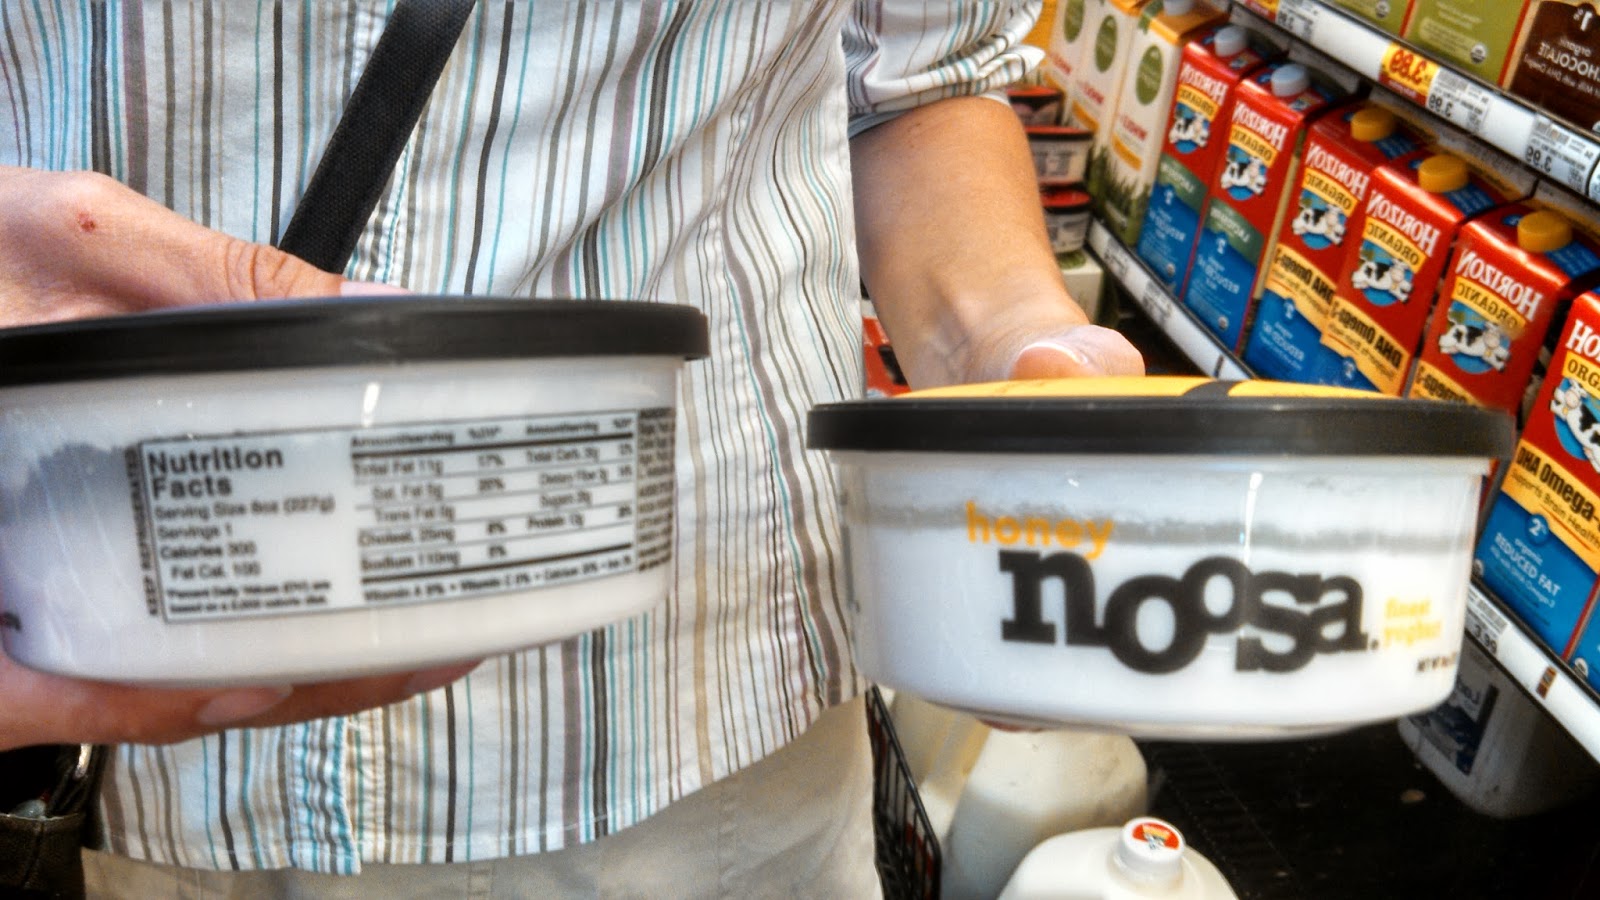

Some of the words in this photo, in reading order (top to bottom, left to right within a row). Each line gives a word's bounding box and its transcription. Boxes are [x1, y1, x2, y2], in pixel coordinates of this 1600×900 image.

[1565, 318, 1600, 363] HO
[148, 446, 284, 475] Nutrition
[151, 476, 233, 499] Facts
[1509, 466, 1544, 500] Supports
[1544, 496, 1567, 522] Brain
[1516, 447, 1539, 478] DHA
[1539, 464, 1600, 533] Omega-
[155, 505, 211, 522] Serving
[157, 523, 221, 541] Servings
[965, 500, 1114, 560] honey
[160, 544, 224, 561] Calories
[1494, 532, 1538, 579] REDUCED
[1538, 570, 1562, 599] FAT
[171, 564, 195, 579] Fat
